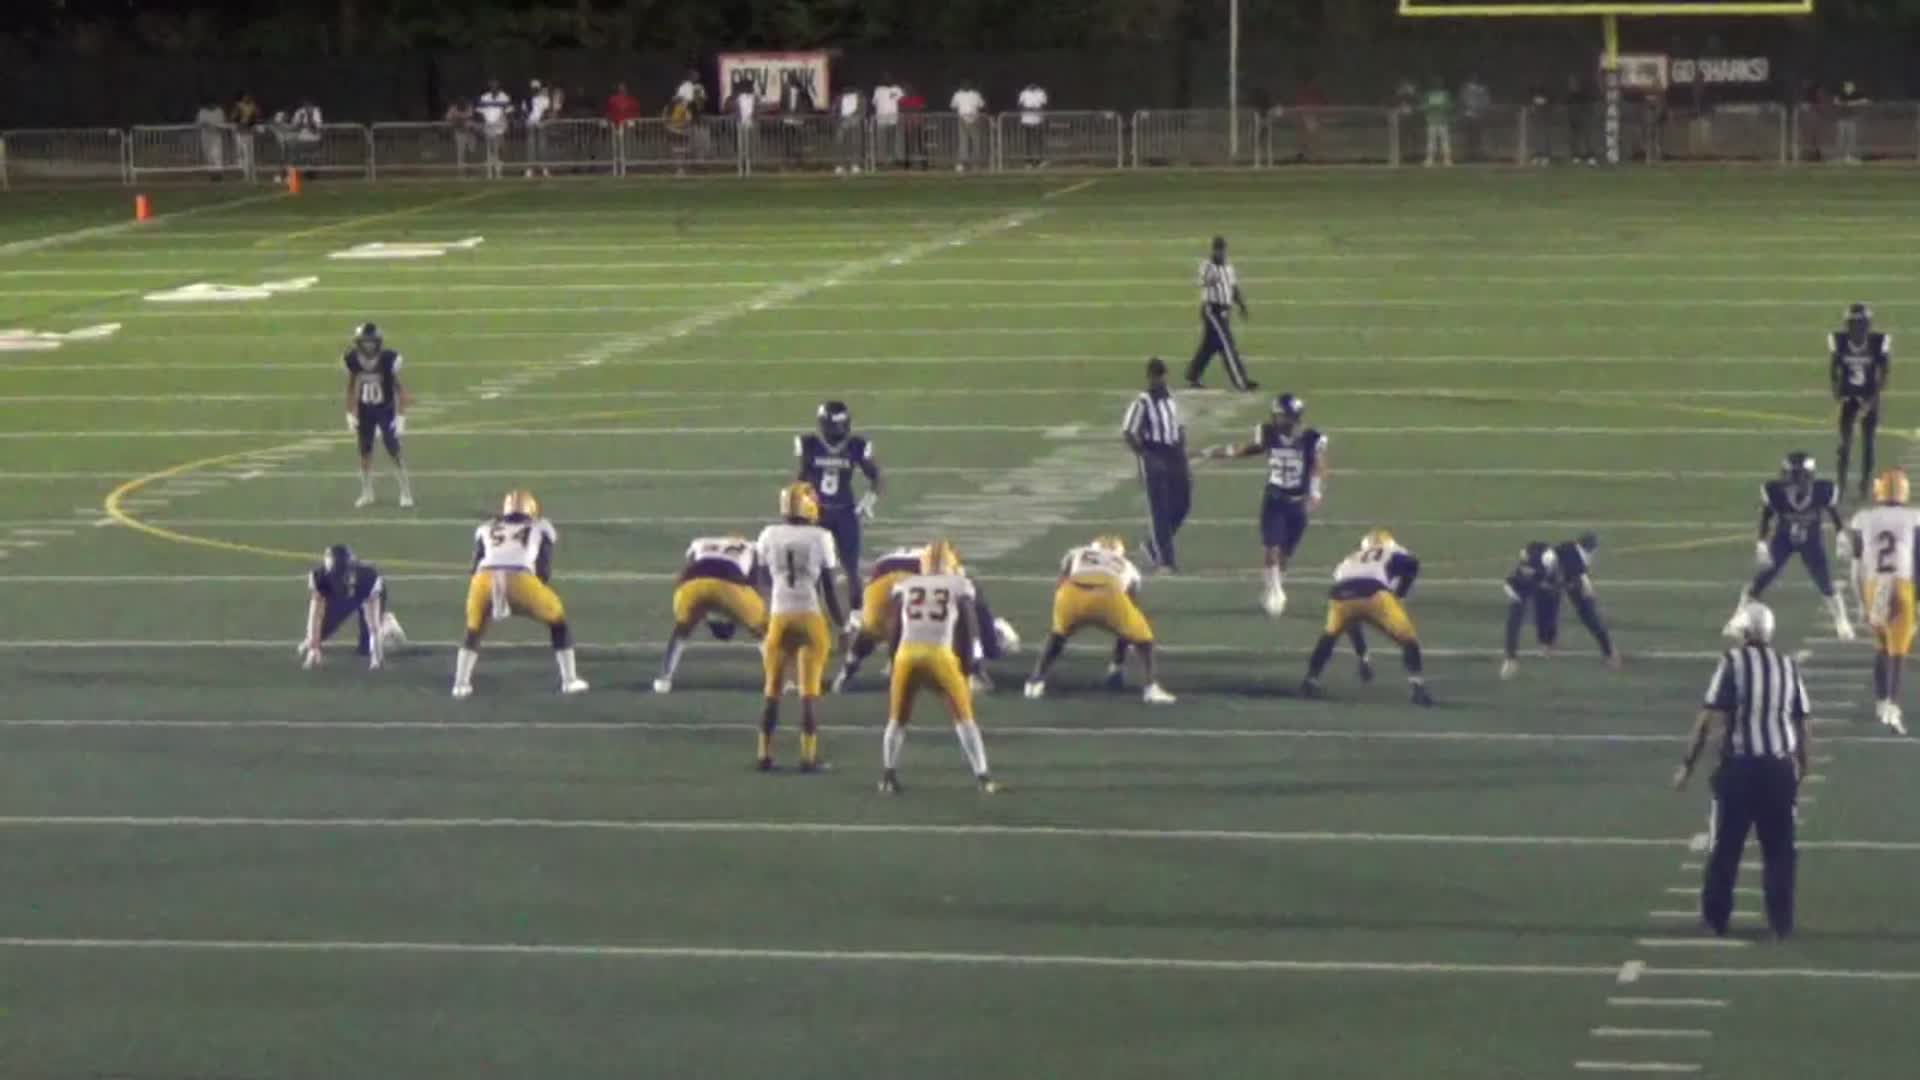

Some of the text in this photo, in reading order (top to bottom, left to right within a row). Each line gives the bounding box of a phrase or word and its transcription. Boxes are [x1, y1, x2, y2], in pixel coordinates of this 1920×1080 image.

[1672, 59, 1695, 82] GO
[489, 525, 532, 548] 54
[1876, 530, 1897, 573] 2
[908, 587, 949, 622] 23
